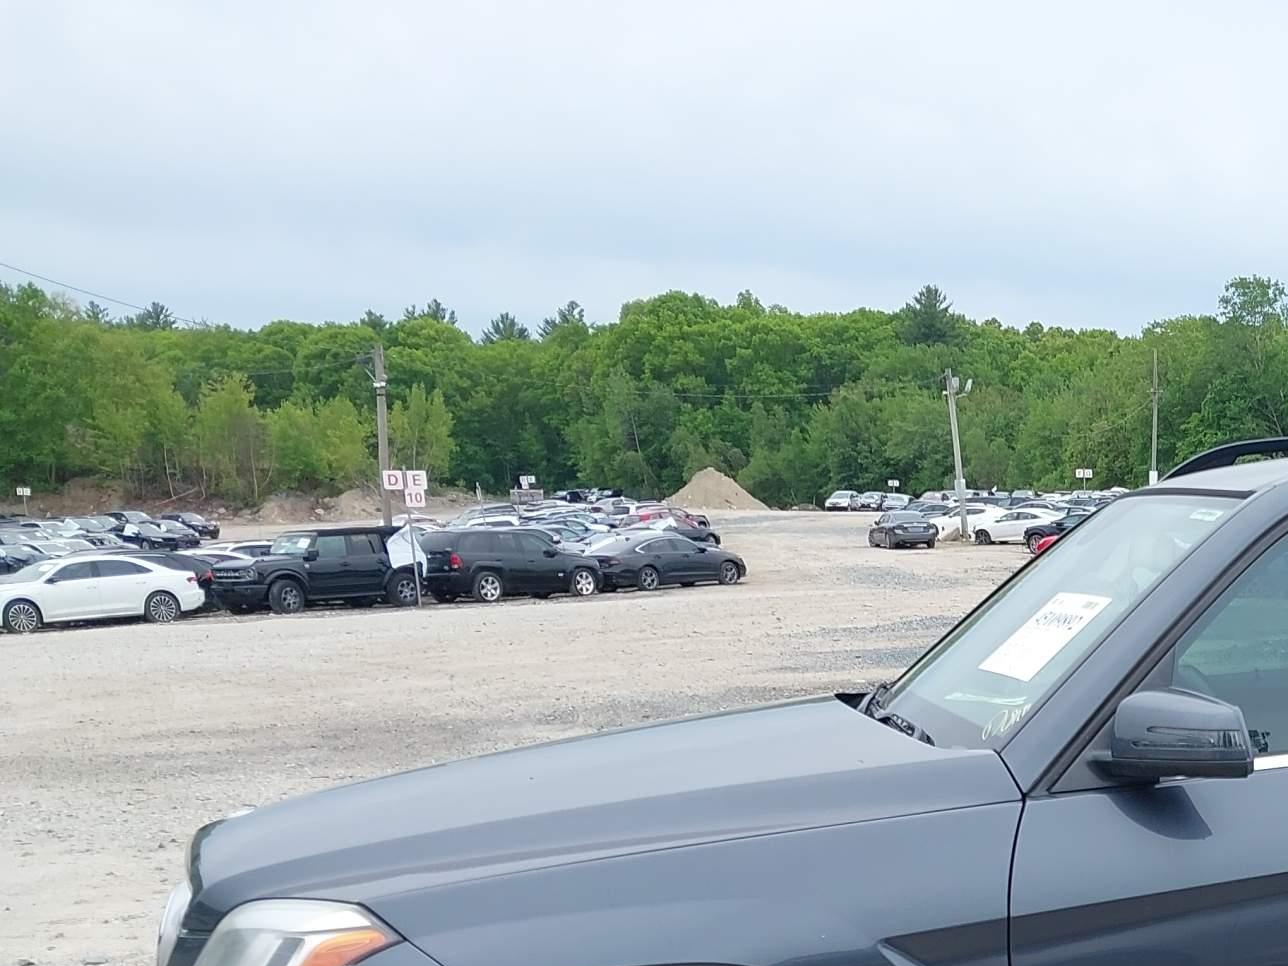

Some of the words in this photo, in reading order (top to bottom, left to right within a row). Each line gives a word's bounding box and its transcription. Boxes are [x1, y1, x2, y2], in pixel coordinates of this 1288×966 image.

[388, 474, 398, 486] D
[413, 474, 422, 486] E
[407, 492, 423, 504] 10
